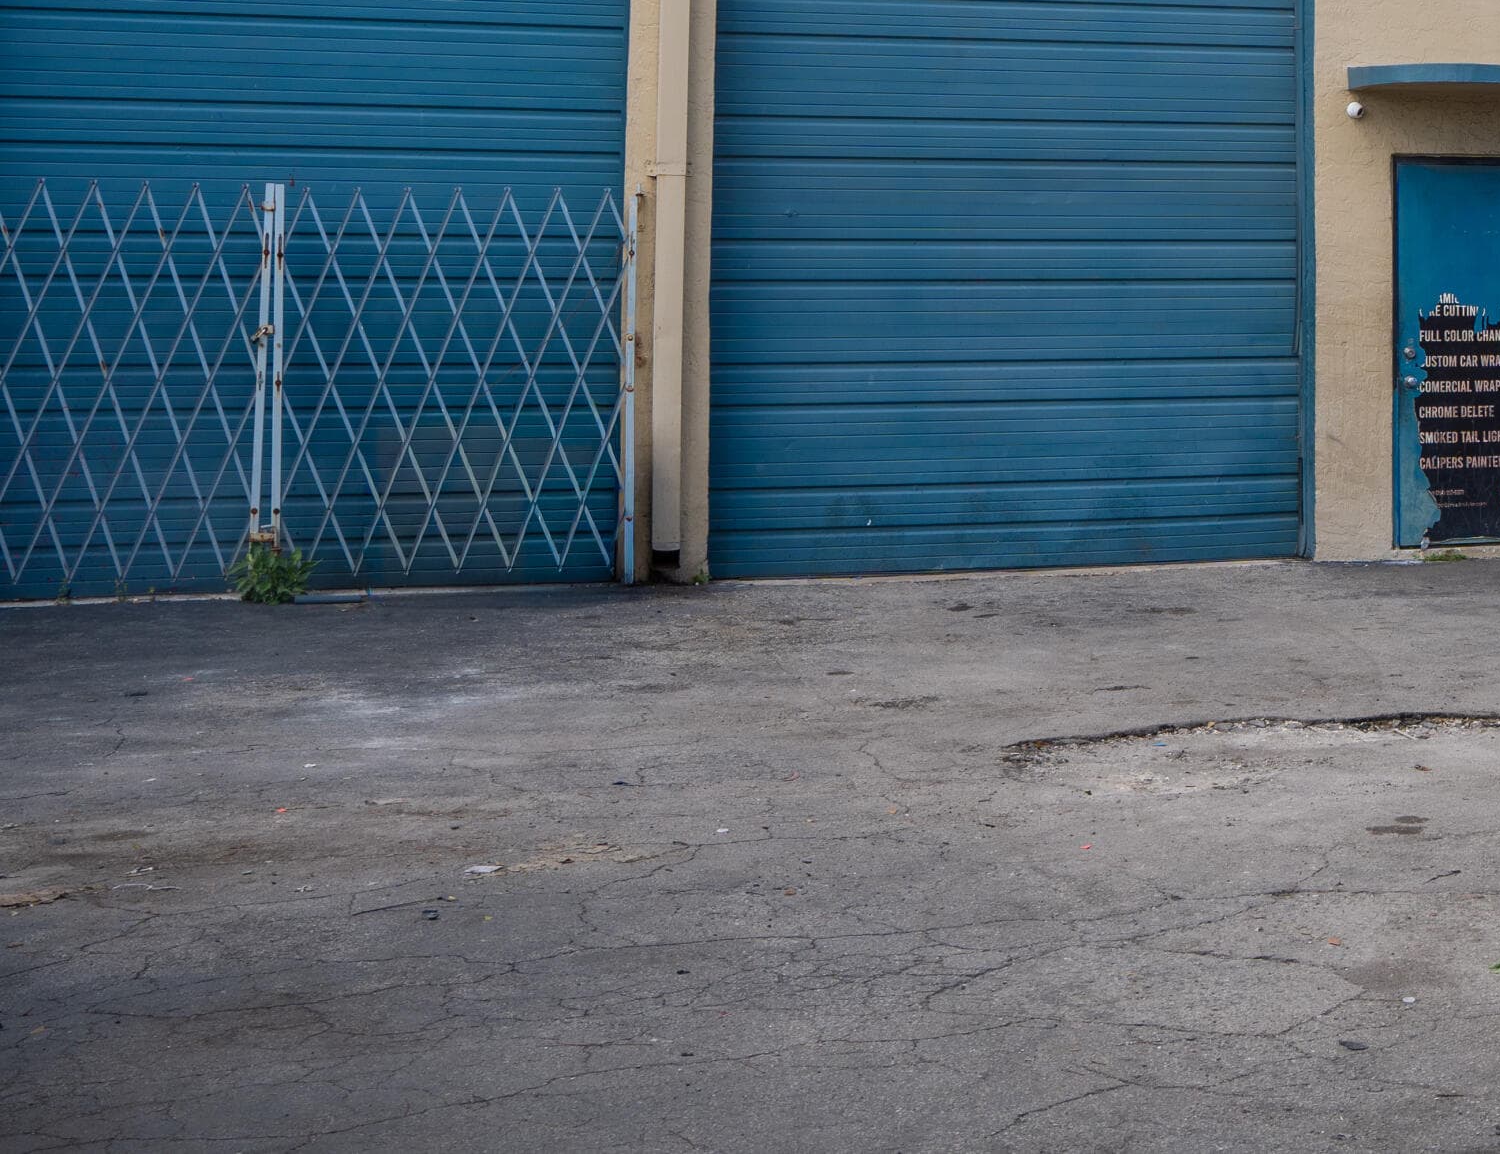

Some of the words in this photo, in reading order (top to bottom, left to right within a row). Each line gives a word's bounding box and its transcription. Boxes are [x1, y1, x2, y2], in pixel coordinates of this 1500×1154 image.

[1443, 305, 1485, 317] CUTTIN
[1419, 329, 1442, 342] FULL
[1444, 329, 1474, 342] COLOR
[1421, 355, 1457, 367] USTOM
[1459, 355, 1478, 367] CAR
[1419, 380, 1472, 393] COMERCIAL
[1419, 405, 1459, 418] CHROME
[1461, 405, 1495, 418] DELETE
[1419, 431, 1458, 444] SMOKED
[1461, 430, 1480, 443] TAIL
[1419, 456, 1463, 469] CALIPERS
